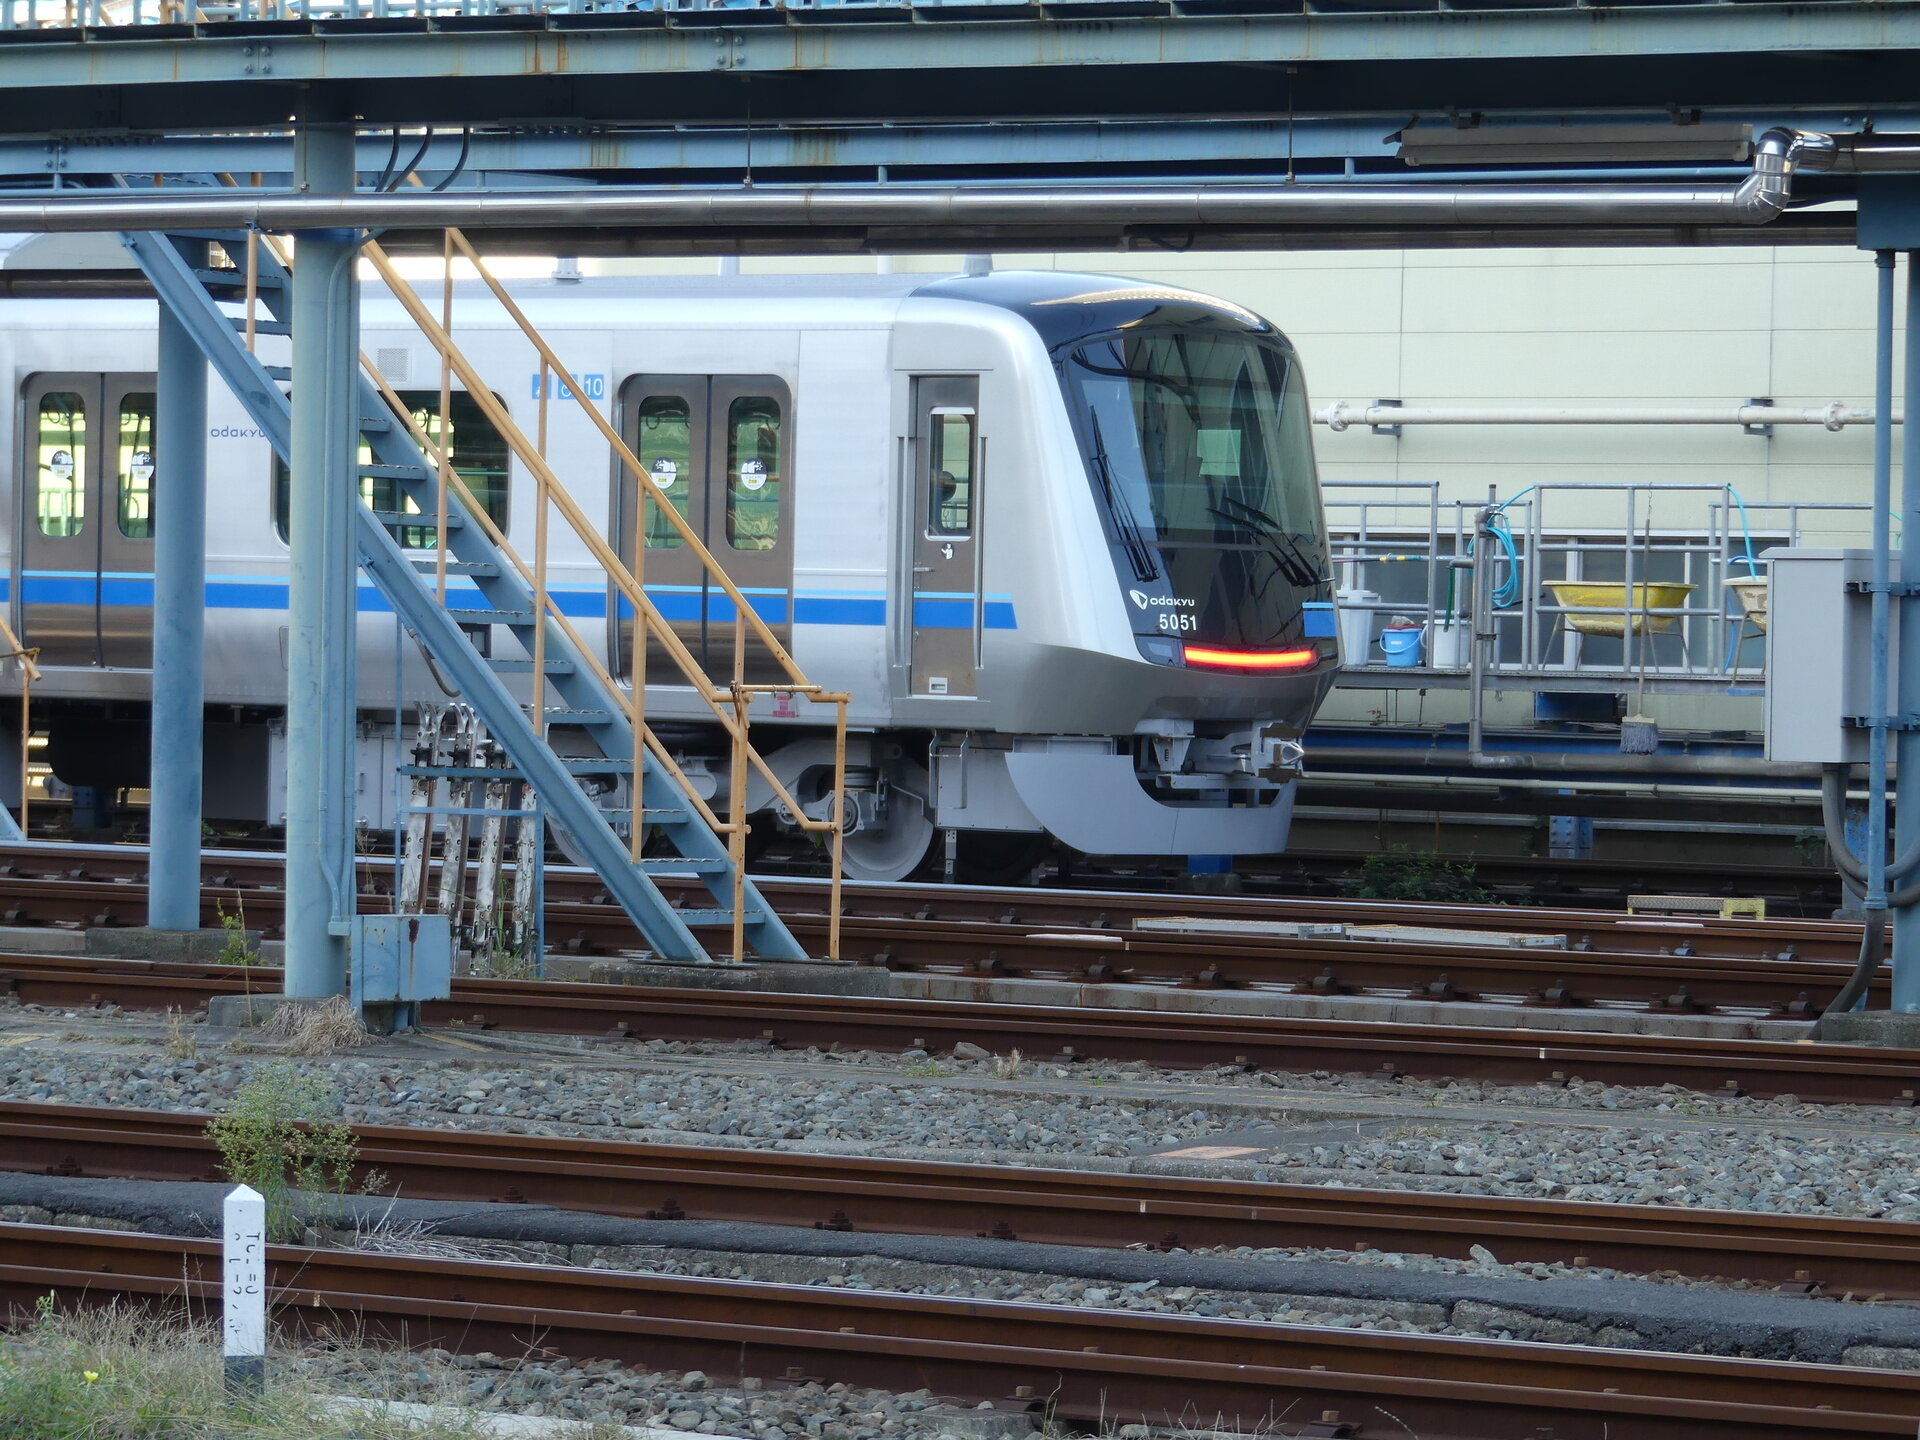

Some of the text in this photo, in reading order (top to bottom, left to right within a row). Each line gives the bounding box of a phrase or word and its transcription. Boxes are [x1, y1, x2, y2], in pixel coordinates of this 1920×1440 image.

[585, 378, 603, 396] 10
[210, 425, 266, 438] odakyu
[1150, 595, 1195, 607] odakyu
[1159, 613, 1197, 631] 5051
